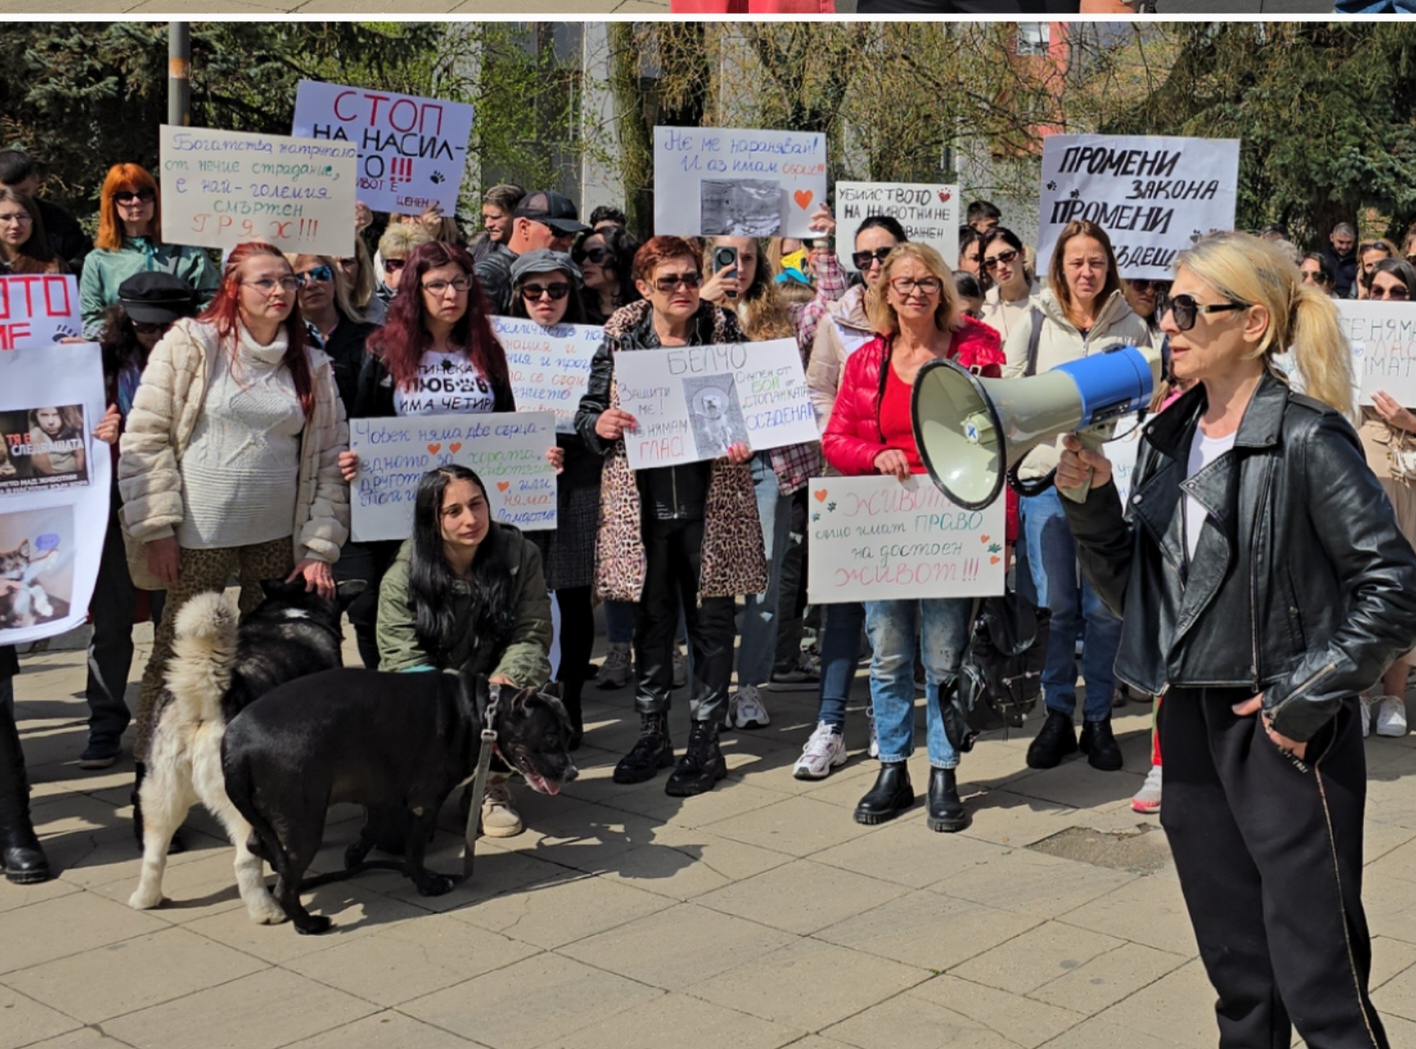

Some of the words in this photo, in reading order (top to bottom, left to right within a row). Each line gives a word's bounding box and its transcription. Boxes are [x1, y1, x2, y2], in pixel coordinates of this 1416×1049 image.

[334, 91, 443, 136] СТОП
[313, 124, 348, 141] НА
[664, 129, 692, 151] Не
[701, 137, 721, 151] ме
[681, 155, 700, 172] И
[707, 159, 727, 172] аз
[732, 159, 778, 172] имам
[1058, 147, 1181, 176] ПРОМЕНИ
[839, 188, 931, 206] УБИЙСТВОТО
[1125, 180, 1220, 200] ЗАКОНА
[844, 205, 861, 219] НА
[934, 208, 951, 221] НЕ
[1050, 199, 1174, 234] ПРОМЕНИ
[667, 342, 747, 376] БЕЛЧО
[400, 399, 434, 411] ИМА
[418, 427, 462, 442] няма
[880, 542, 963, 568] достоен
